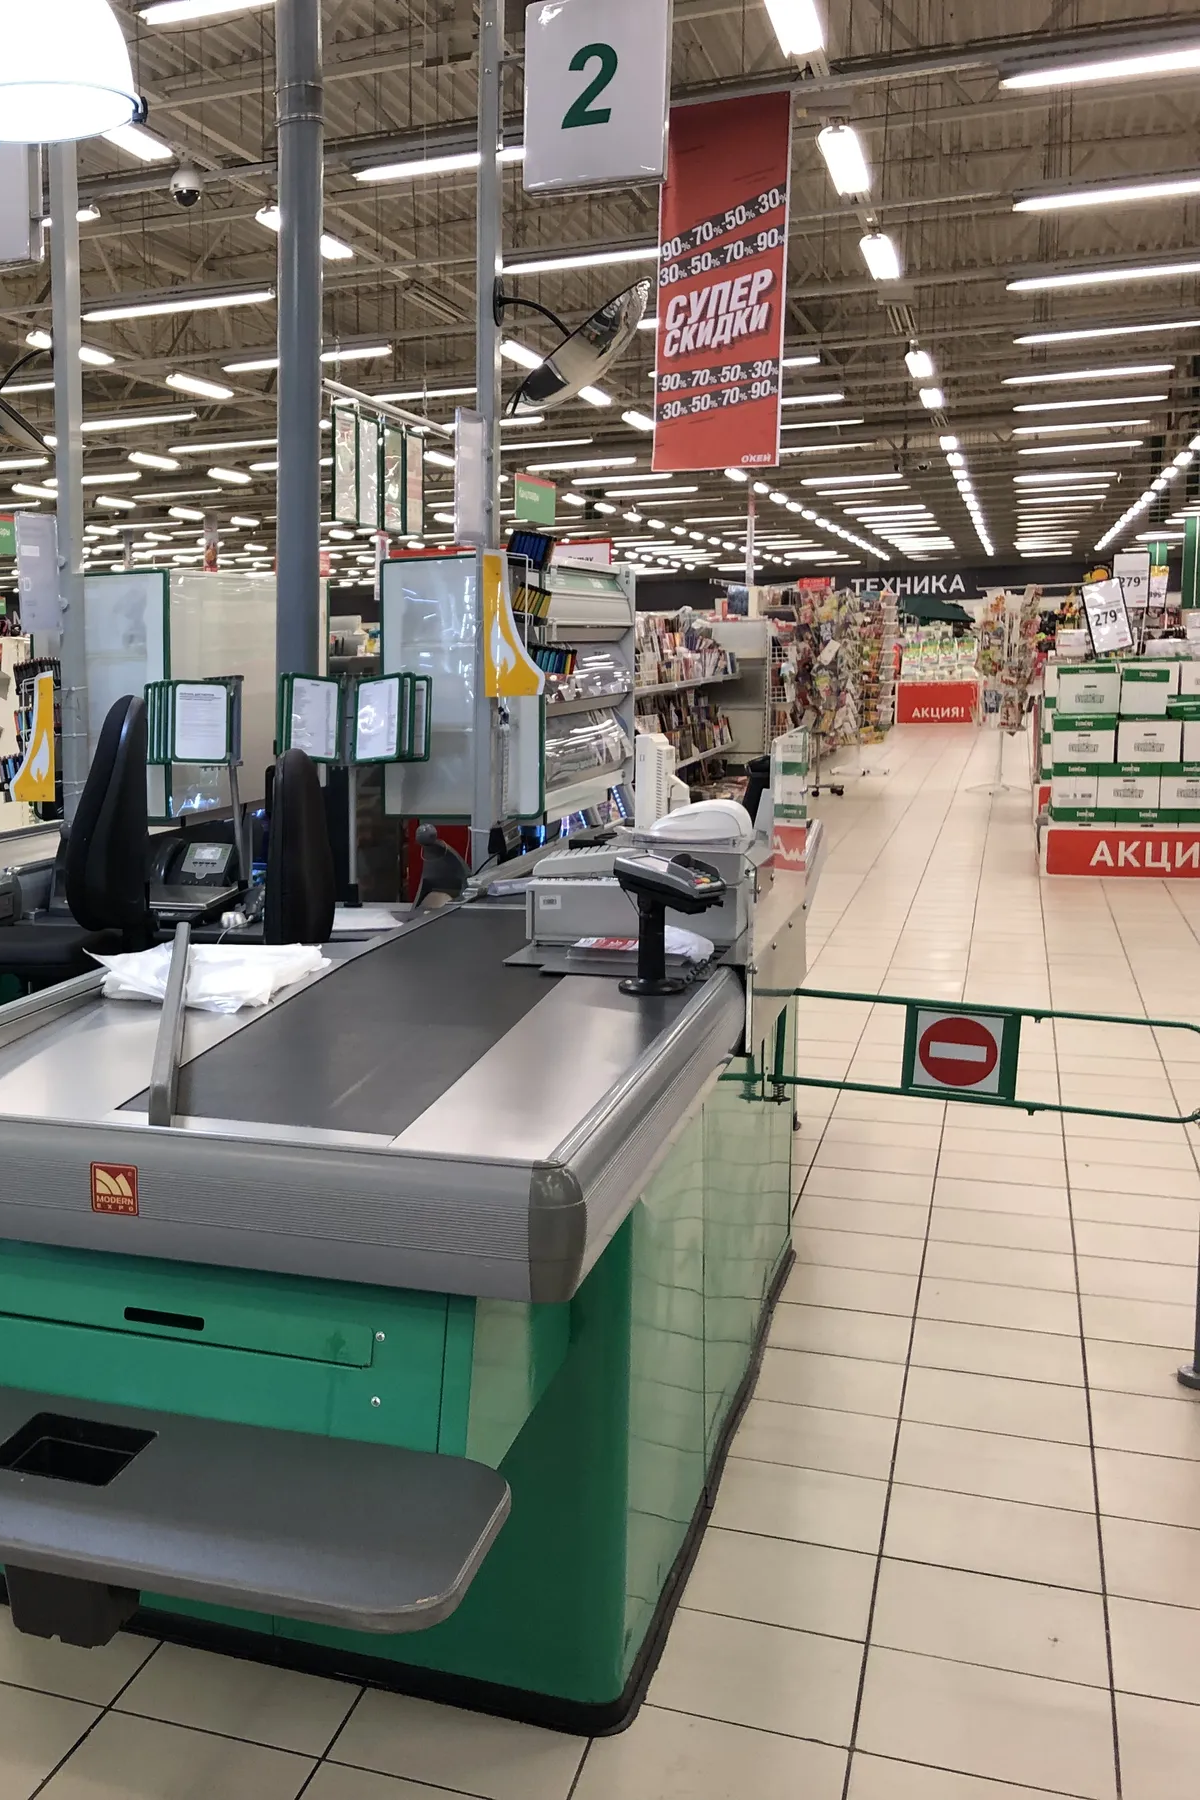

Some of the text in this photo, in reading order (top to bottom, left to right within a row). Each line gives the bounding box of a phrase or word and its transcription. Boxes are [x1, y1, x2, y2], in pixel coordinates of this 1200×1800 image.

[561, 42, 619, 130] 2
[665, 268, 774, 331] СУПЕР
[663, 302, 770, 358] СКИДКИ
[851, 574, 966, 597] ТЕХНИКА
[1119, 576, 1141, 588] 279
[1093, 609, 1118, 627] 279
[911, 706, 965, 719] АКЦИЯ!
[96, 1195, 134, 1206] MODERN
